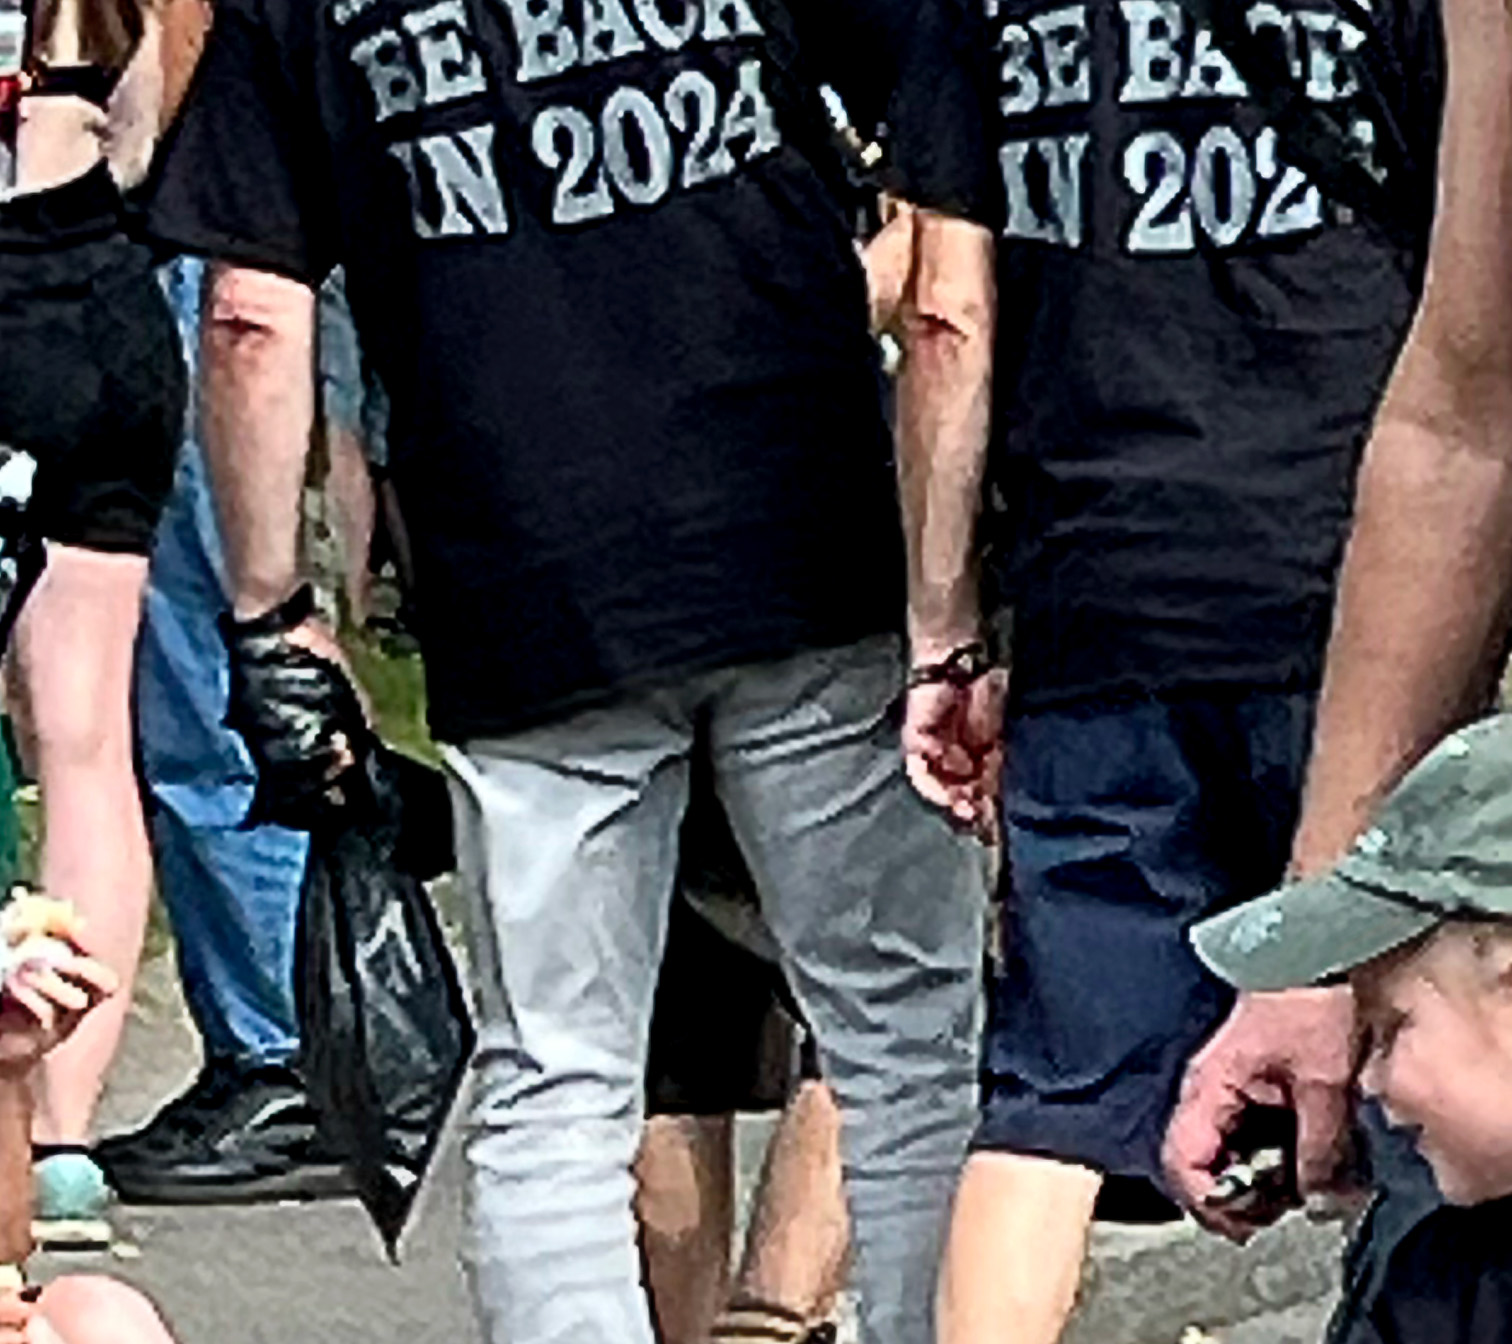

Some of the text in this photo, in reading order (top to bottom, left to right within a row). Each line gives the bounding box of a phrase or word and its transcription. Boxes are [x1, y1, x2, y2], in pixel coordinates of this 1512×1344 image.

[350, 0, 487, 122] BE
[531, 59, 782, 225] 2024
[1123, 121, 1388, 253] 202
